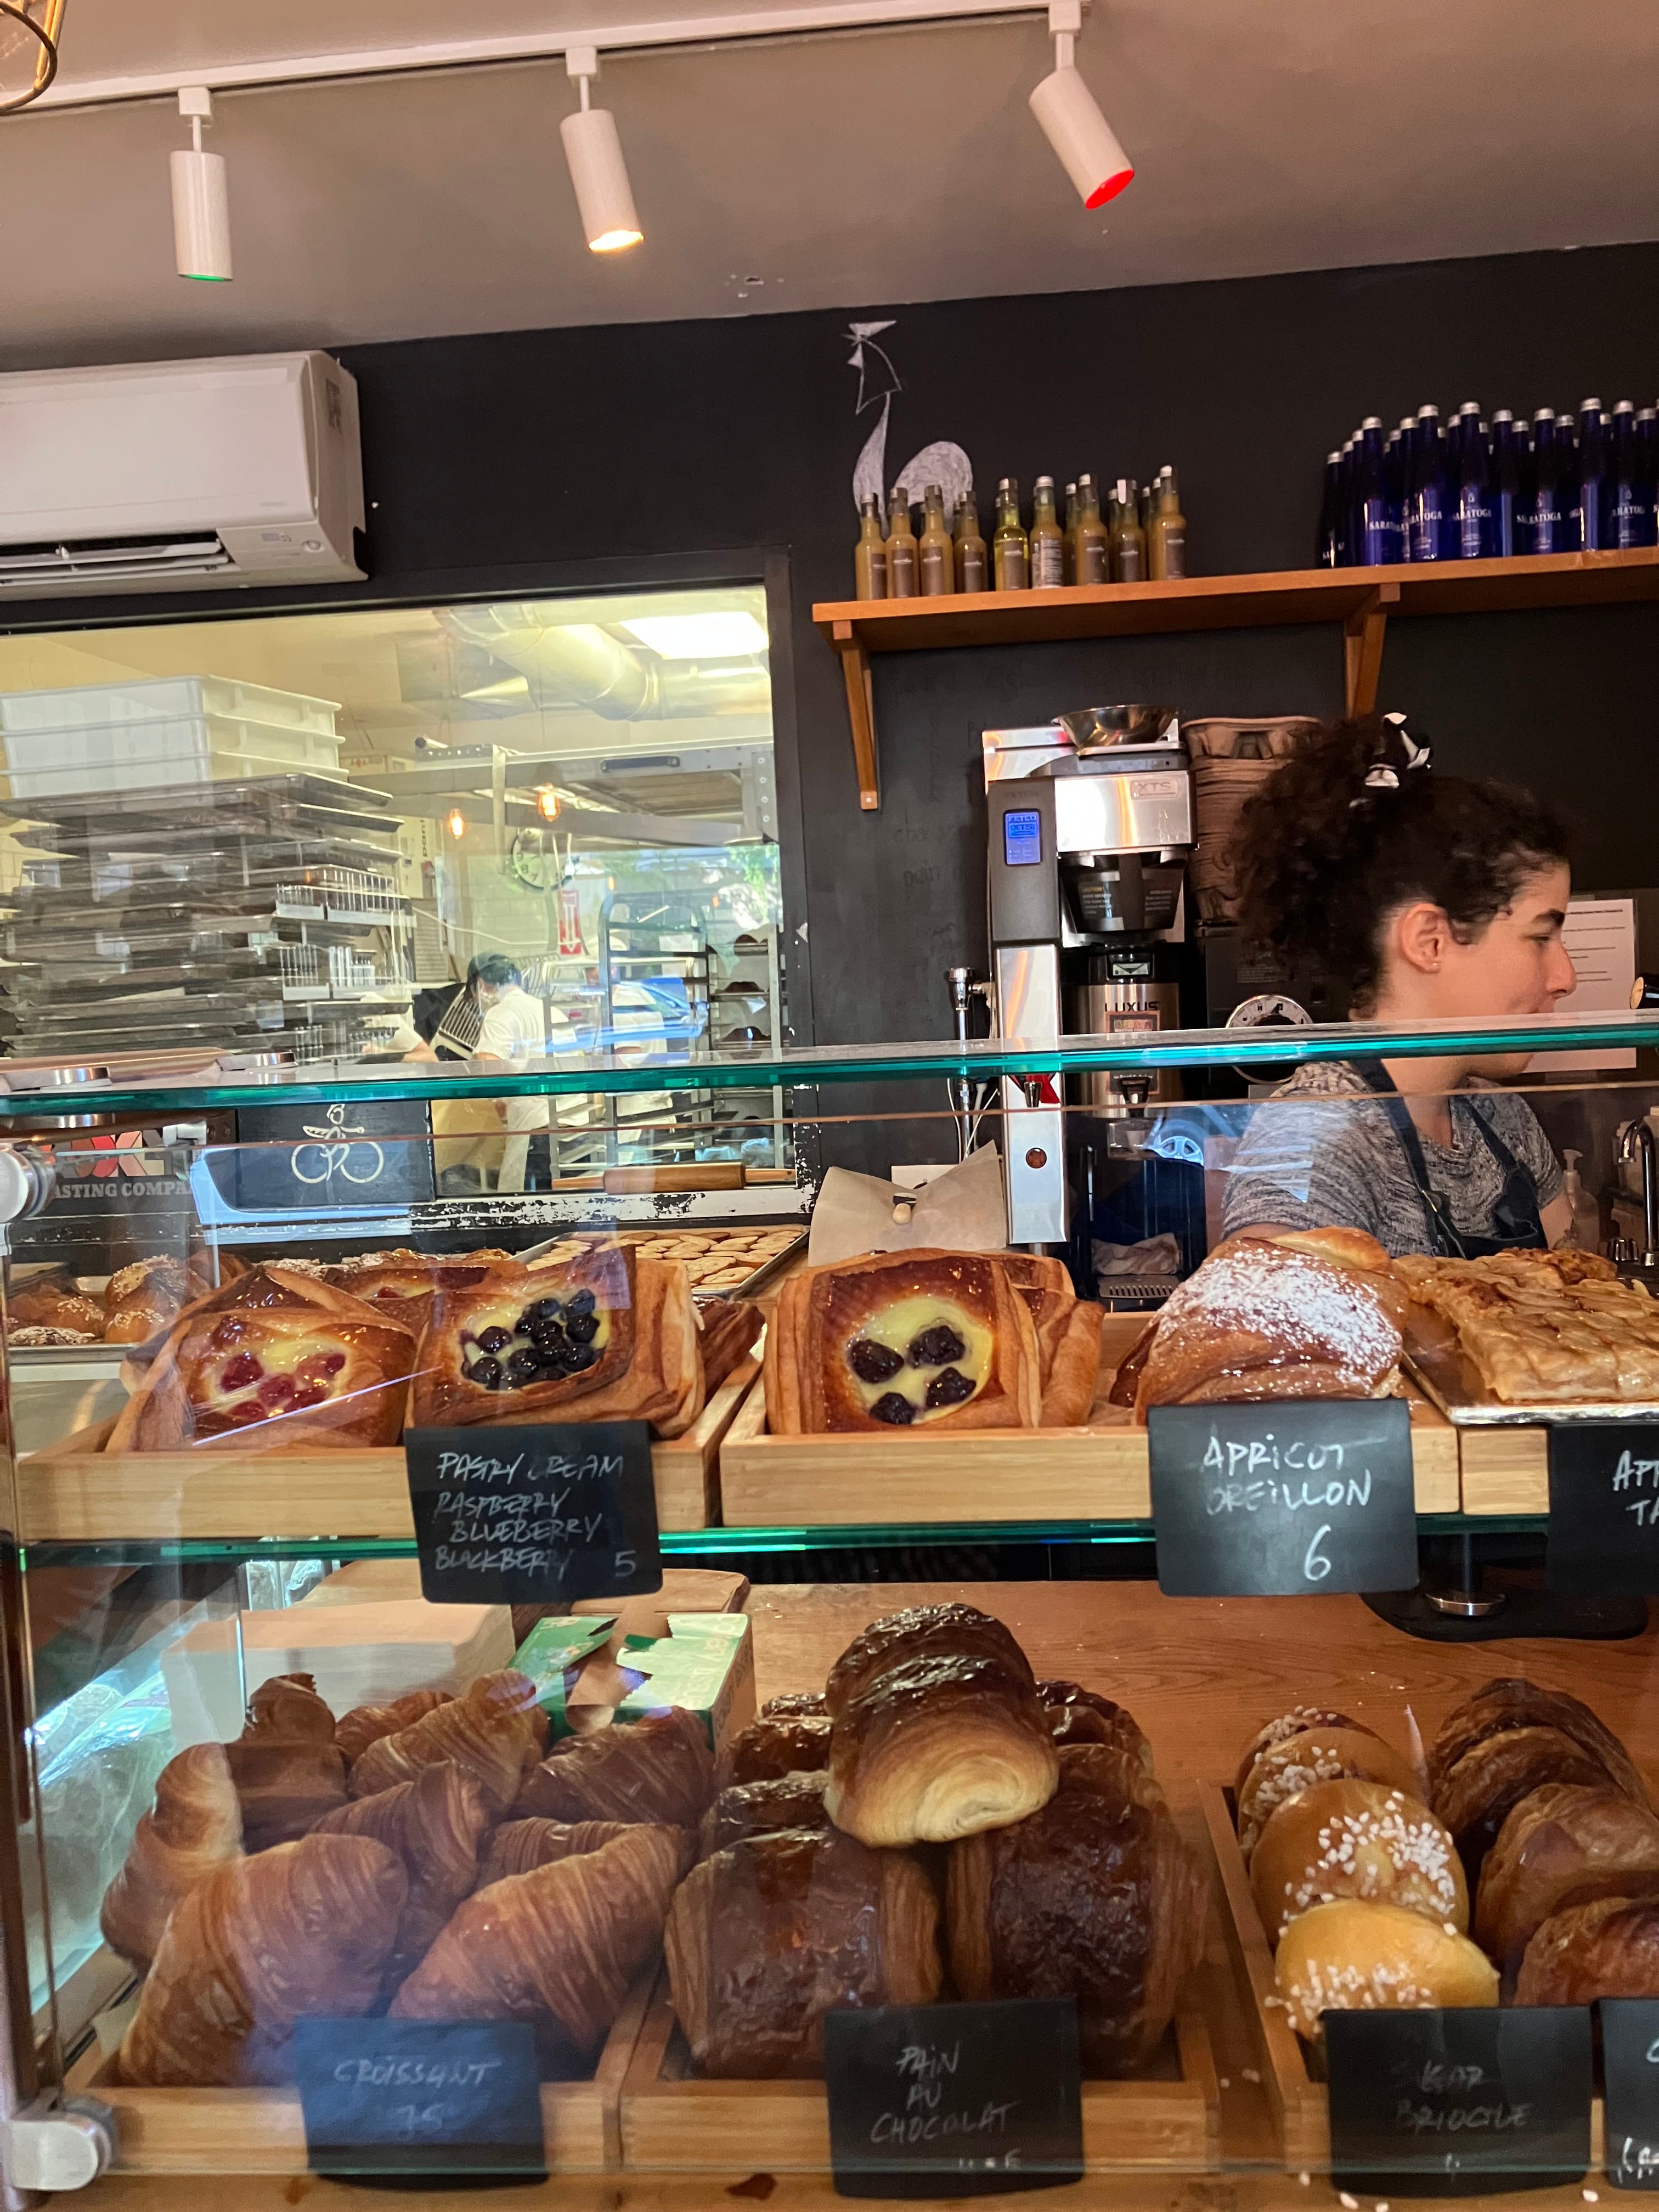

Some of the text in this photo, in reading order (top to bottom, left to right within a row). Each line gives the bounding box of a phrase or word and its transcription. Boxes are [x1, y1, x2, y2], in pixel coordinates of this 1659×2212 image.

[1138, 782, 1172, 792] XTS
[55, 1181, 191, 1199] ASTING COMPA
[437, 1452, 524, 1485] PASTRY
[435, 1487, 571, 1519] RASPBERRY
[449, 1513, 602, 1543] BLUEBERRY
[614, 1550, 636, 1578] 5
[1304, 1525, 1331, 1581] 6
[906, 2081, 942, 2111] AU
[870, 2100, 1022, 2144] CHOCOLAT
